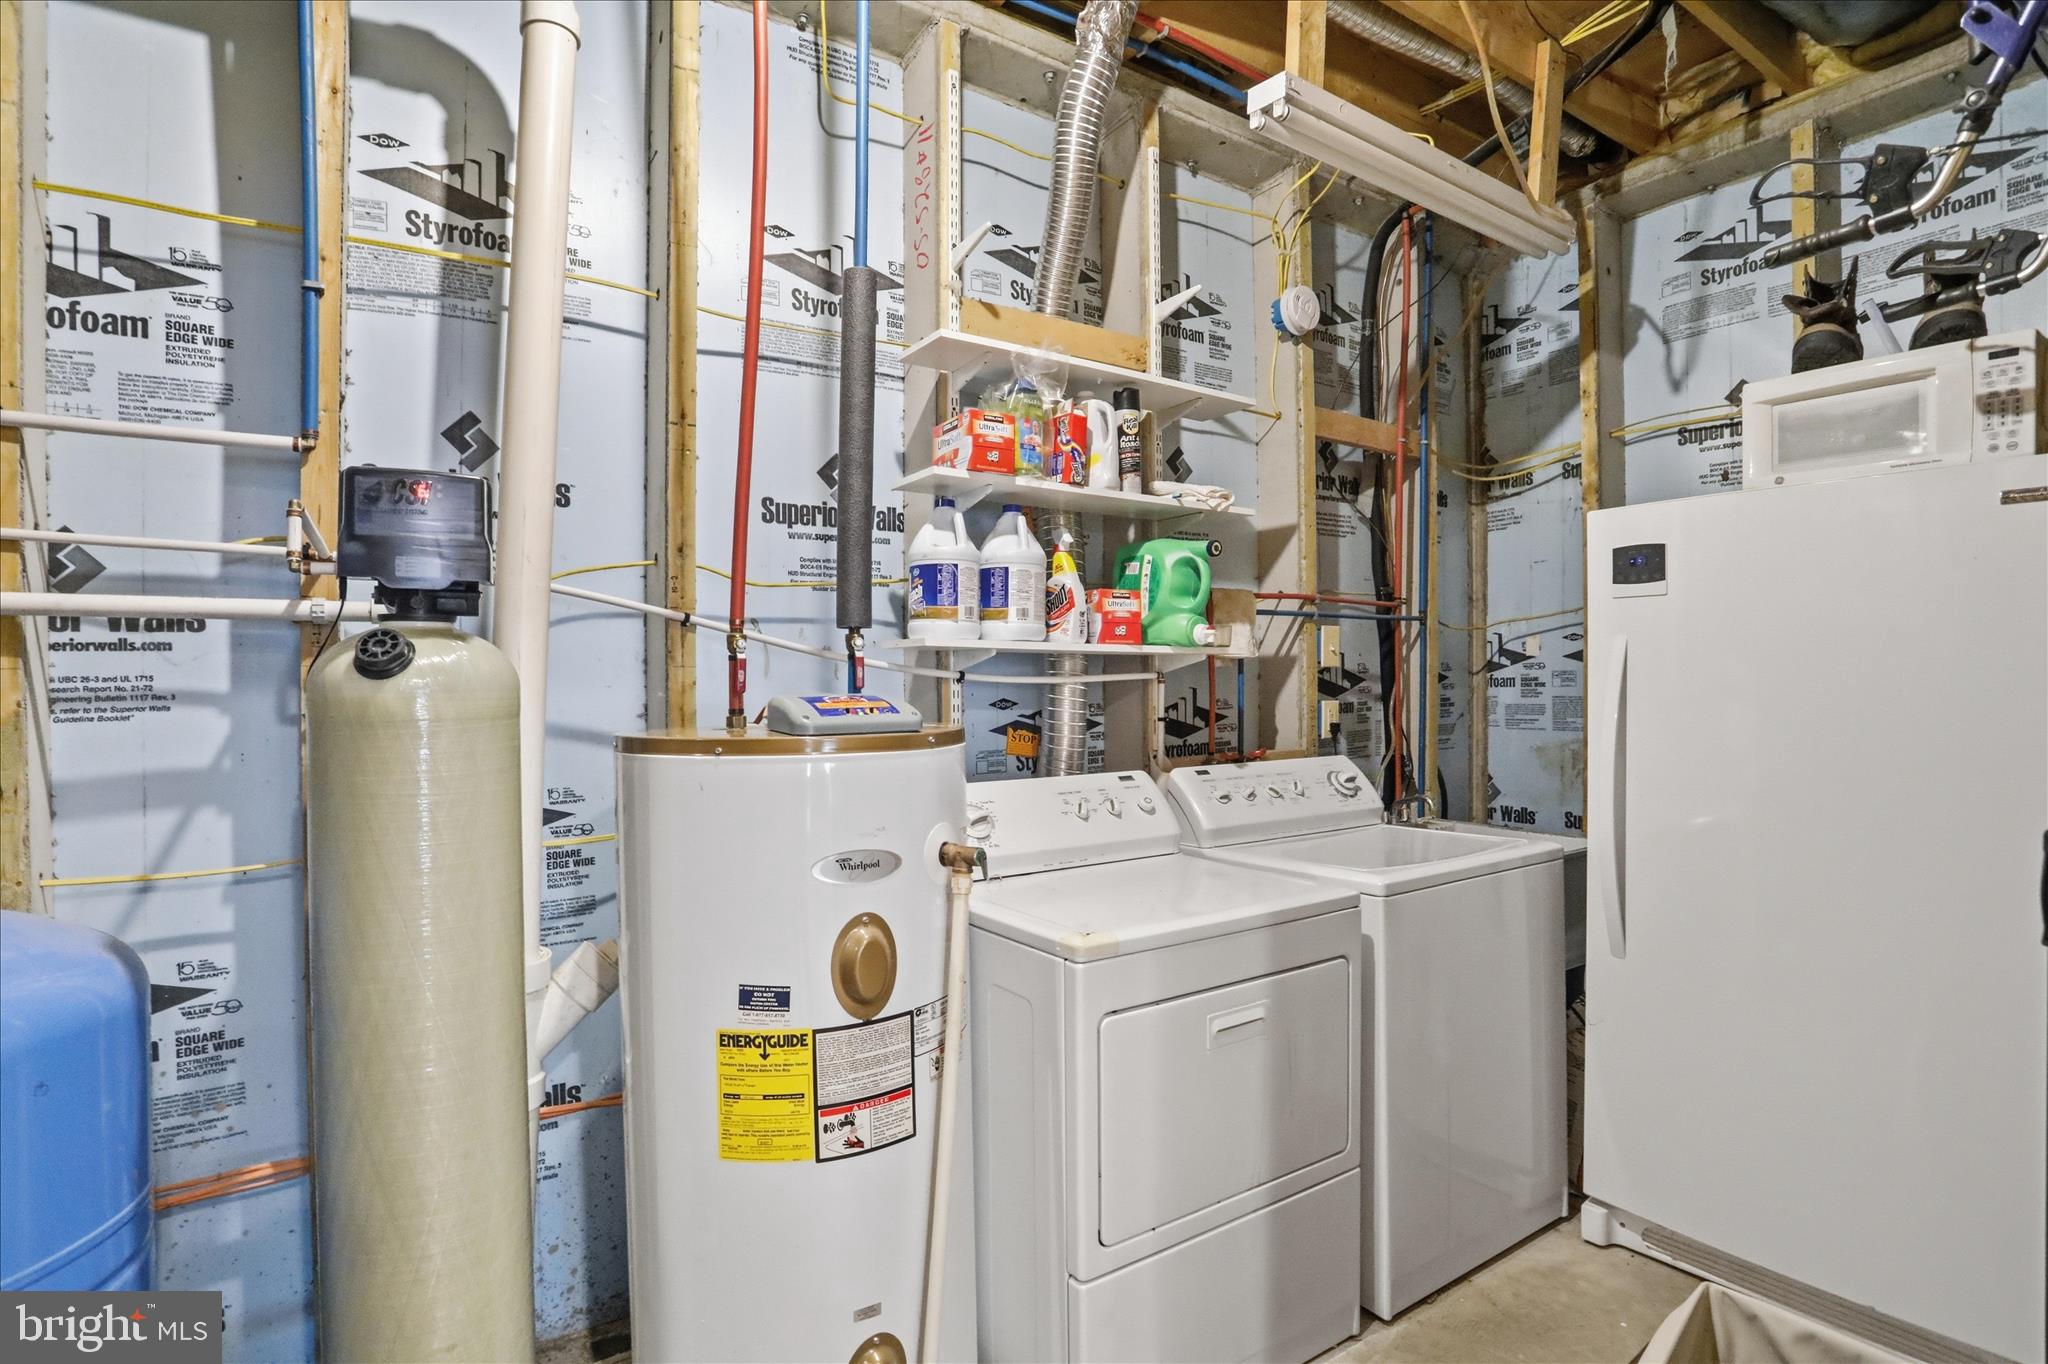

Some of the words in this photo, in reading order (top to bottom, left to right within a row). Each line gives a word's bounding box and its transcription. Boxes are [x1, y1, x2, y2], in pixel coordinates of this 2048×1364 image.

[369, 134, 400, 148] DOW
[2006, 183, 2031, 198] EDGE
[167, 246, 187, 262] 15
[170, 261, 223, 273] WARRANTY
[569, 257, 592, 269] WIDE
[171, 295, 202, 305] VALUE
[165, 319, 215, 335] SQUARE
[886, 319, 903, 330] EDGE
[165, 331, 199, 345] EDGE
[202, 335, 235, 349] WIDE
[165, 344, 212, 355] EXTRUDED
[165, 357, 216, 369] INSULATION
[1120, 435, 1135, 443] Ant
[1046, 583, 1068, 616] SHOUT
[58, 675, 78, 683] UBC
[80, 675, 100, 683] 26-3
[101, 674, 118, 683] and
[120, 675, 132, 683] UL
[134, 675, 154, 683] 1715
[82, 685, 112, 695] Report
[114, 685, 129, 693] No.
[130, 684, 154, 693] 21-72
[94, 694, 128, 703] Bulletin
[129, 694, 150, 702] 1117
[151, 694, 169, 702] Rev.
[59, 707, 80, 715] refer
[82, 706, 92, 714] to
[94, 705, 108, 714] the
[109, 705, 146, 715] Superior
[148, 705, 171, 713] Walls
[52, 715, 95, 724] Guideline
[1010, 733, 1037, 744] STOP
[547, 788, 561, 801] 15
[1500, 805, 1536, 825] Walls
[1564, 811, 1584, 832] Su
[546, 849, 582, 861] SQUARE
[546, 860, 570, 871] EDGE
[572, 856, 596, 868] WIDE
[839, 859, 880, 872] Whirlpool
[176, 961, 196, 977] 15
[179, 971, 231, 982] WARRANTY
[181, 1007, 212, 1017] VALUE
[174, 1026, 201, 1036] BRAND
[175, 1030, 226, 1048] SQUARE
[719, 1033, 809, 1049] ENERGYGUIDE
[175, 1044, 209, 1059] EDGE
[212, 1037, 245, 1052] WIDE
[176, 1054, 223, 1068] EXTRUDED
[176, 1058, 237, 1074] POLYSTYRENE
[176, 1066, 228, 1081] INSULATION
